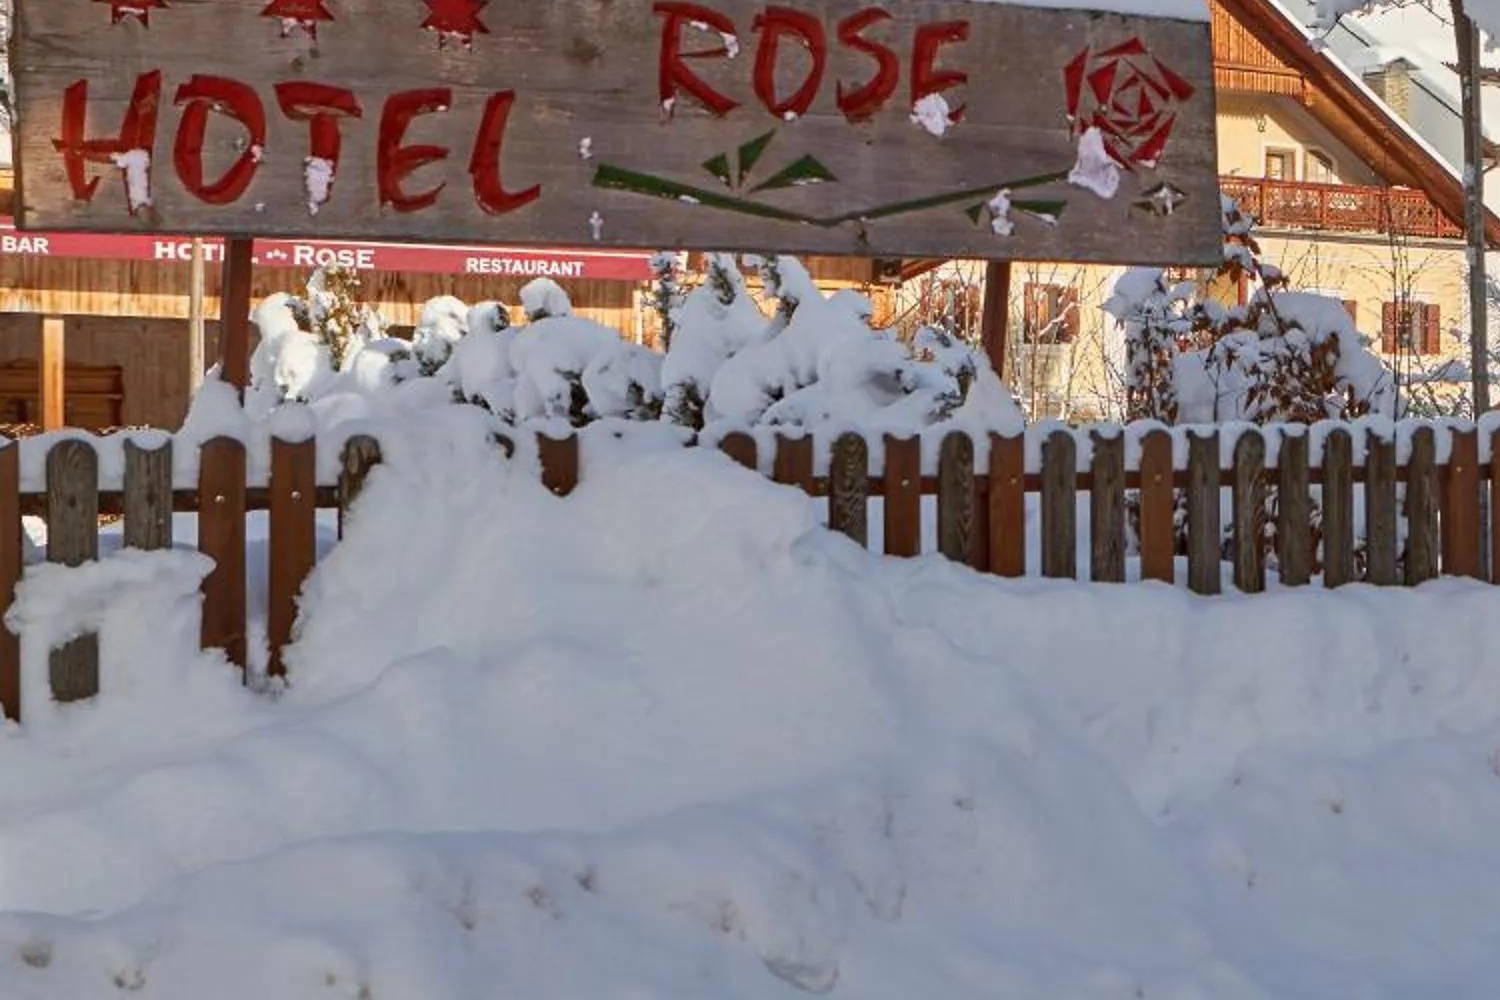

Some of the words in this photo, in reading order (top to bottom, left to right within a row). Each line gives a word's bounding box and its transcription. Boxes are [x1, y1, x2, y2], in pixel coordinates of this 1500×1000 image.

[51, 68, 541, 217] HOTEL
[653, 1, 971, 128] ROSE
[2, 235, 49, 254] BAR
[154, 241, 258, 264] HOT
[293, 245, 376, 269] ROSE
[466, 257, 584, 276] RESTAURANT
